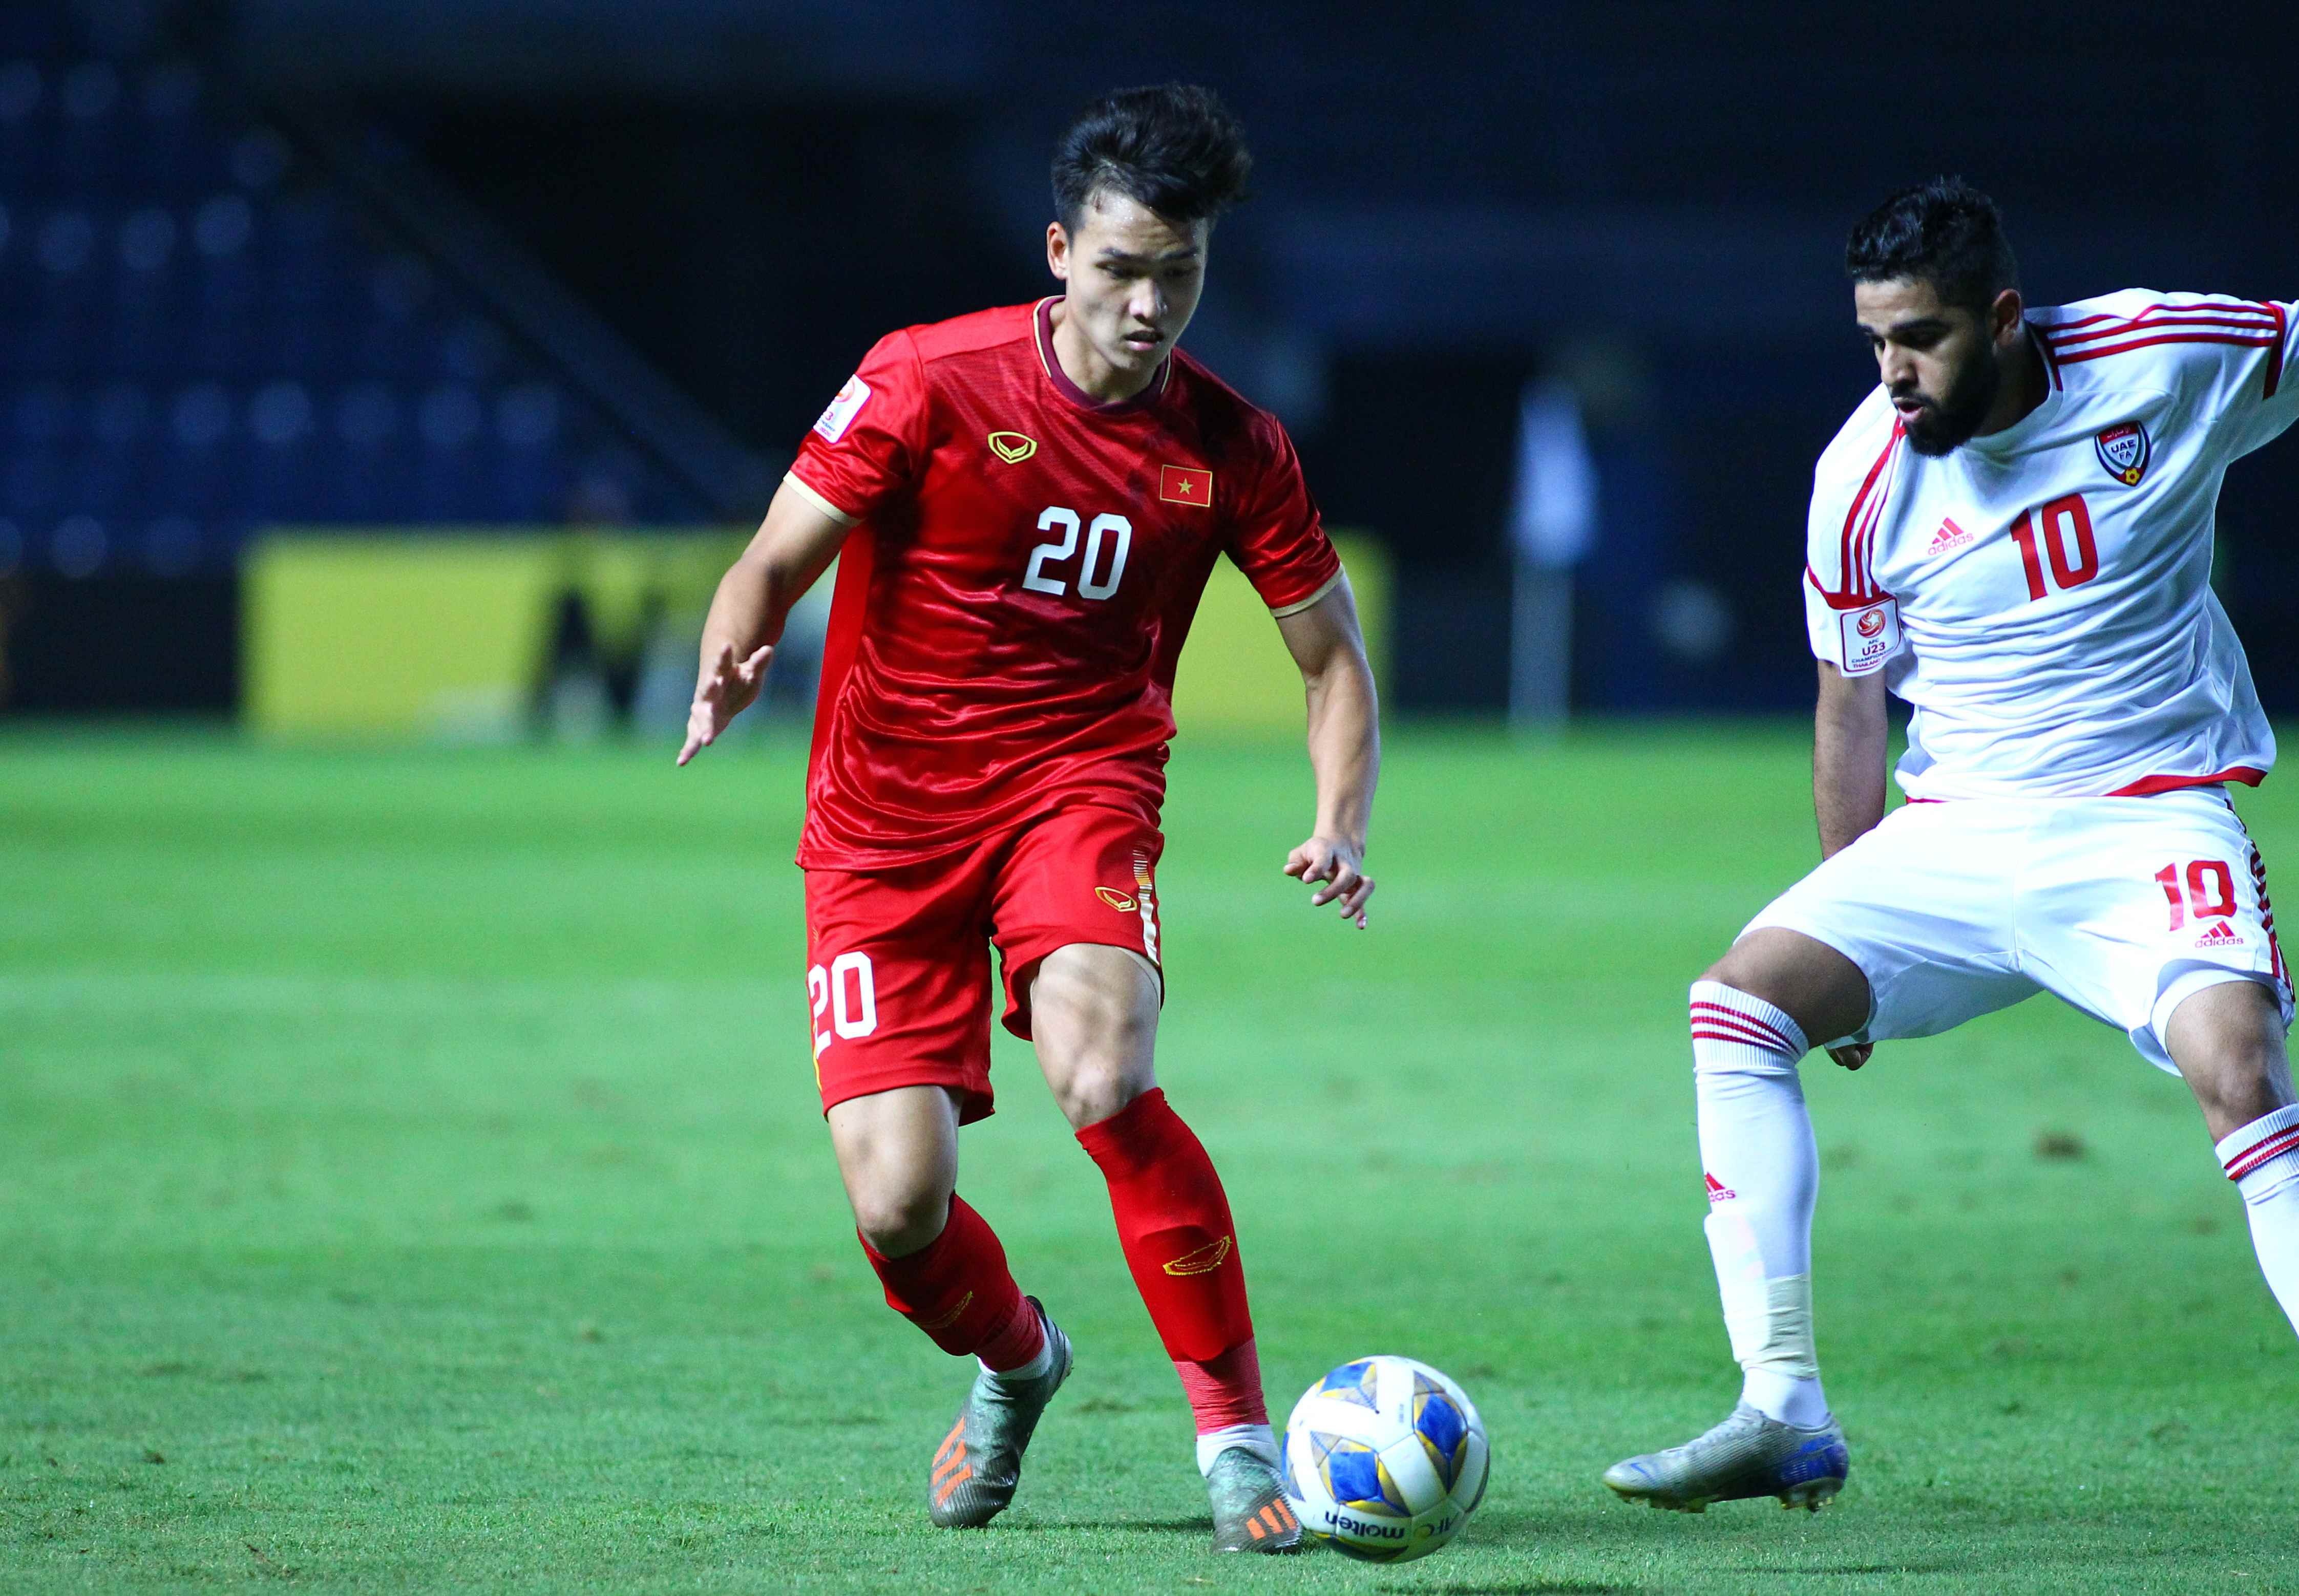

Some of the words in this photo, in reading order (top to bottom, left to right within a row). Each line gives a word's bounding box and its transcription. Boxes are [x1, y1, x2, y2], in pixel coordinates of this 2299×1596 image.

[2110, 439, 2136, 453] UAE
[2119, 451, 2133, 460] FA
[1022, 505, 1133, 601] 20
[1928, 531, 1975, 556] adidas
[2009, 492, 2099, 602] 10
[1862, 642, 1885, 656] U23
[2154, 860, 2238, 932] 10
[2195, 937, 2244, 948] adidas
[808, 950, 878, 1060] 20
[1325, 1510, 1405, 1539] molten
